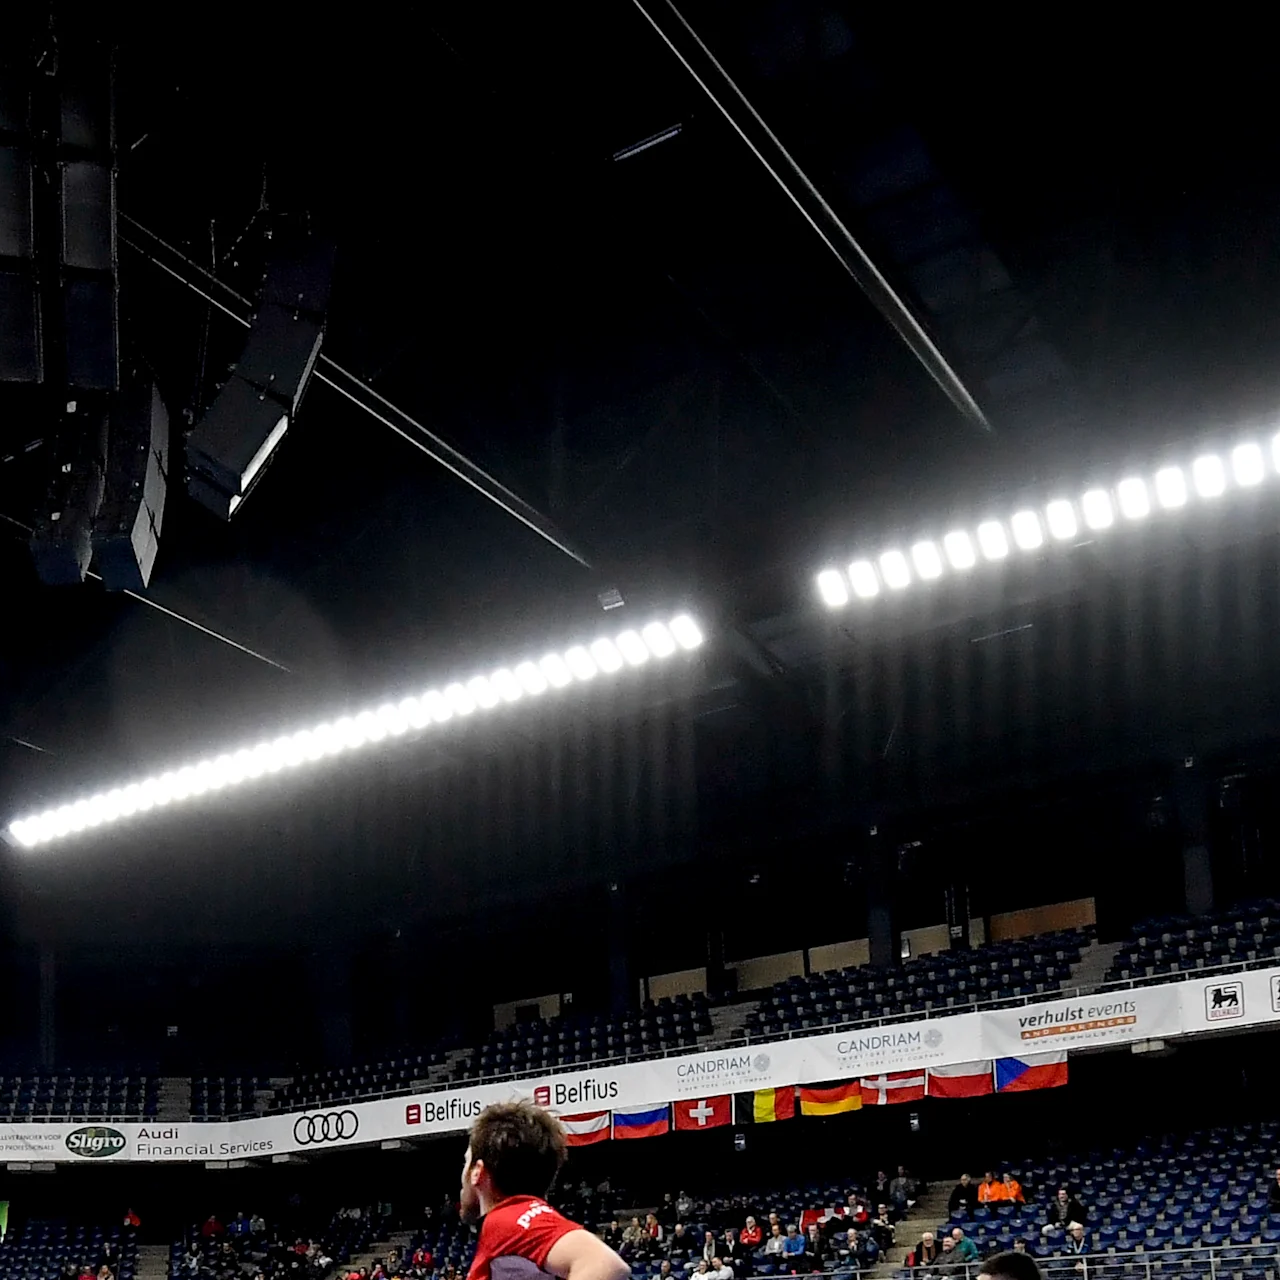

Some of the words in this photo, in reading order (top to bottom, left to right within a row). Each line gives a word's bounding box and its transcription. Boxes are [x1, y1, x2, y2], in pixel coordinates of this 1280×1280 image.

[1019, 1007, 1085, 1028] verhulst
[1087, 1001, 1136, 1018] events
[1059, 1016, 1135, 1032] PARTNERS
[837, 1031, 921, 1054] CANDRIAM
[677, 1055, 751, 1077] CANDRIAM
[556, 1079, 619, 1105] Belfius
[424, 1098, 481, 1122] Belfius
[67, 1133, 124, 1151] Sligro
[137, 1128, 179, 1139] Audi
[137, 1143, 215, 1155] Financial
[220, 1140, 273, 1155] Services
